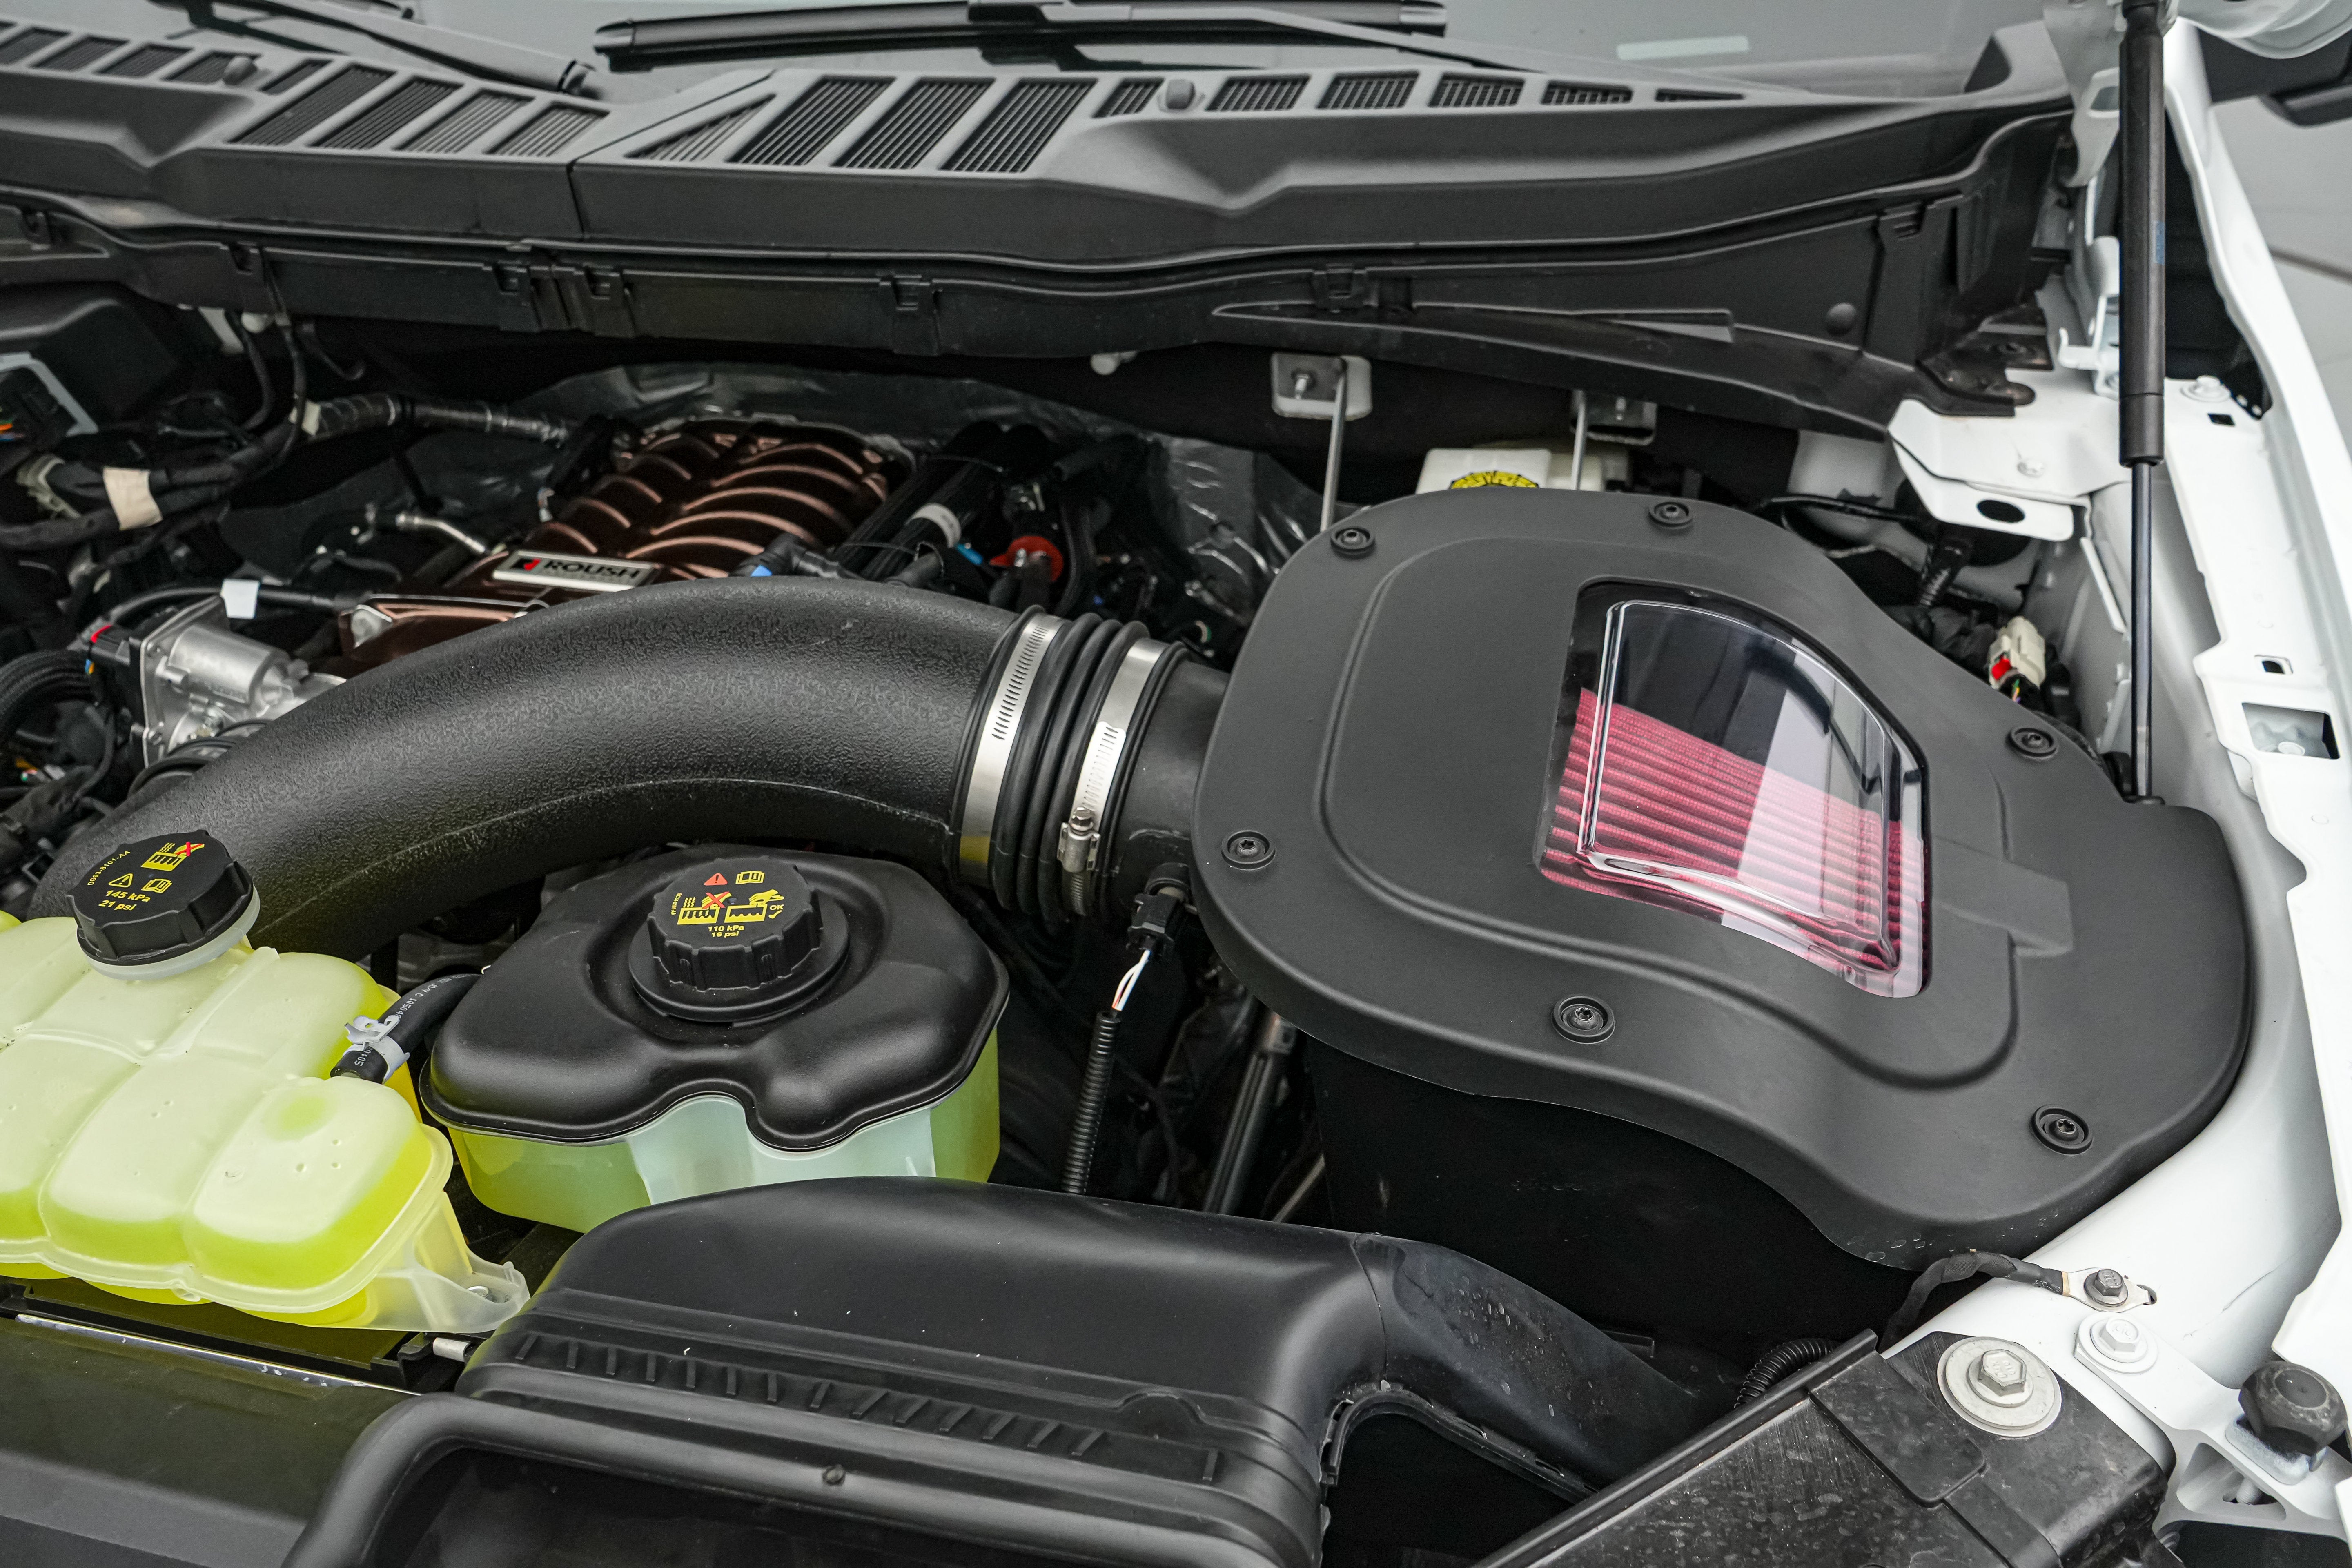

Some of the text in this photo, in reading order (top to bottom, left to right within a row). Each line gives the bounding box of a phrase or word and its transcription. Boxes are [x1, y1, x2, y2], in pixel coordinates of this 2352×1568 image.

[544, 561, 639, 578] ROUSH
[87, 851, 131, 886] DG93-8101-AA
[105, 890, 151, 902] 145 kPa
[354, 1047, 373, 1066] 0:05
